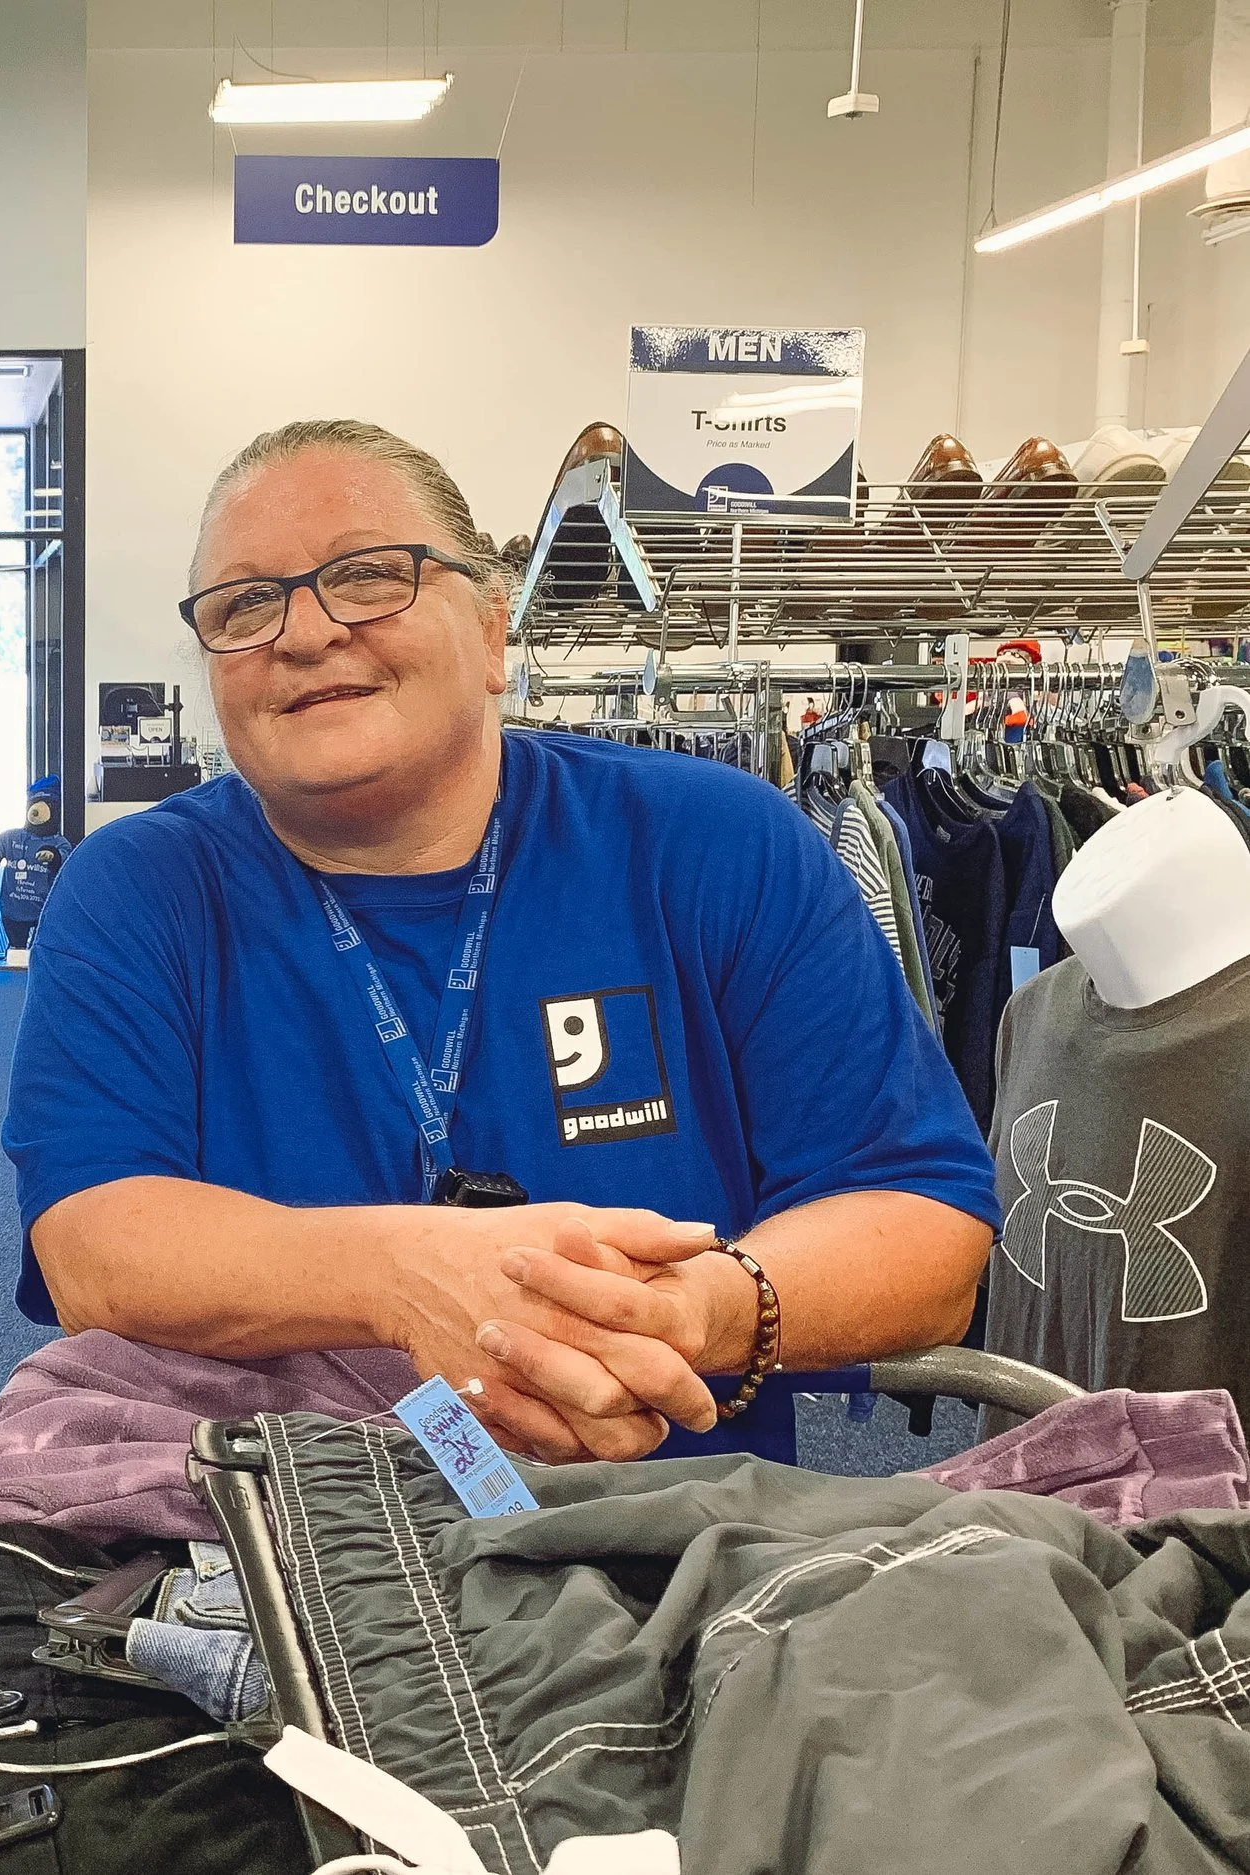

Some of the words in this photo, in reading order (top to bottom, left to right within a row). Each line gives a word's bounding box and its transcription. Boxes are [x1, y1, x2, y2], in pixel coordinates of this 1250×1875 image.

[295, 183, 438, 215] Checkout
[707, 335, 782, 362] MEN
[706, 439, 727, 448] Price
[740, 440, 770, 449] Marked
[461, 932, 475, 968] GOODWILL
[366, 985, 388, 1020] GOODWILL
[441, 1030, 456, 1069] GOODWILL
[412, 1080, 433, 1119] GOODWILL
[563, 1100, 668, 1141] goodwill
[418, 1399, 451, 1427] Goodwill
